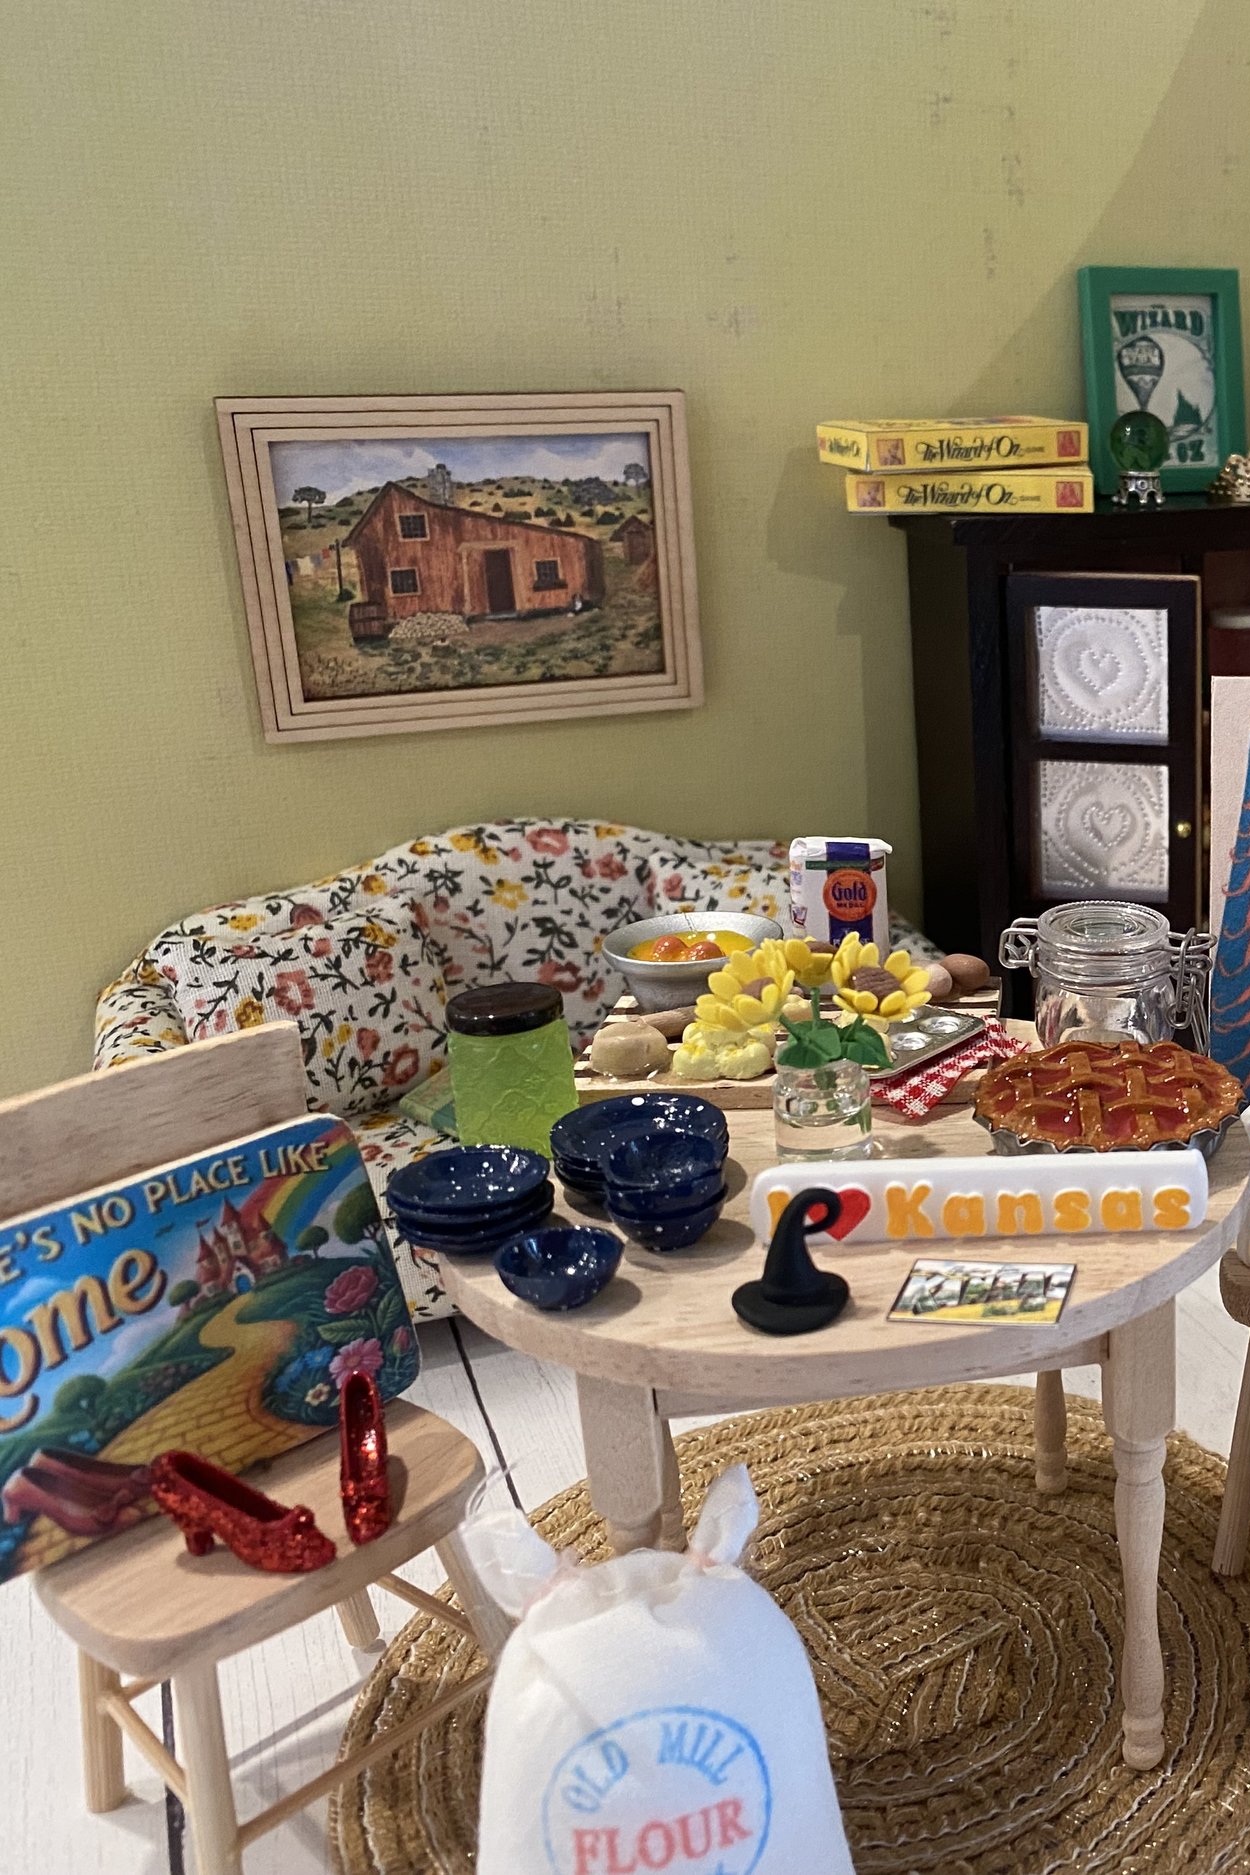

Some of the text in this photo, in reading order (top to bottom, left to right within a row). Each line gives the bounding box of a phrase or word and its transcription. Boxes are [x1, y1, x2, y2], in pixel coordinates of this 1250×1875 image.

[1113, 309, 1205, 338] WIZARD
[915, 441, 939, 463] The
[938, 436, 985, 462] Wizard
[996, 435, 1024, 457] Oz
[1176, 439, 1205, 464] OZ
[897, 484, 923, 506] The
[921, 481, 973, 507] Wizard
[985, 483, 1017, 506] Oz
[831, 880, 868, 901] Gold
[71, 1197, 134, 1245] NO
[144, 1155, 249, 1214] PLACE
[259, 1141, 330, 1179] LIKE
[885, 1184, 1191, 1238] Kansas
[561, 1721, 745, 1813] OLD MILL
[572, 1797, 753, 1875] FLOUR
